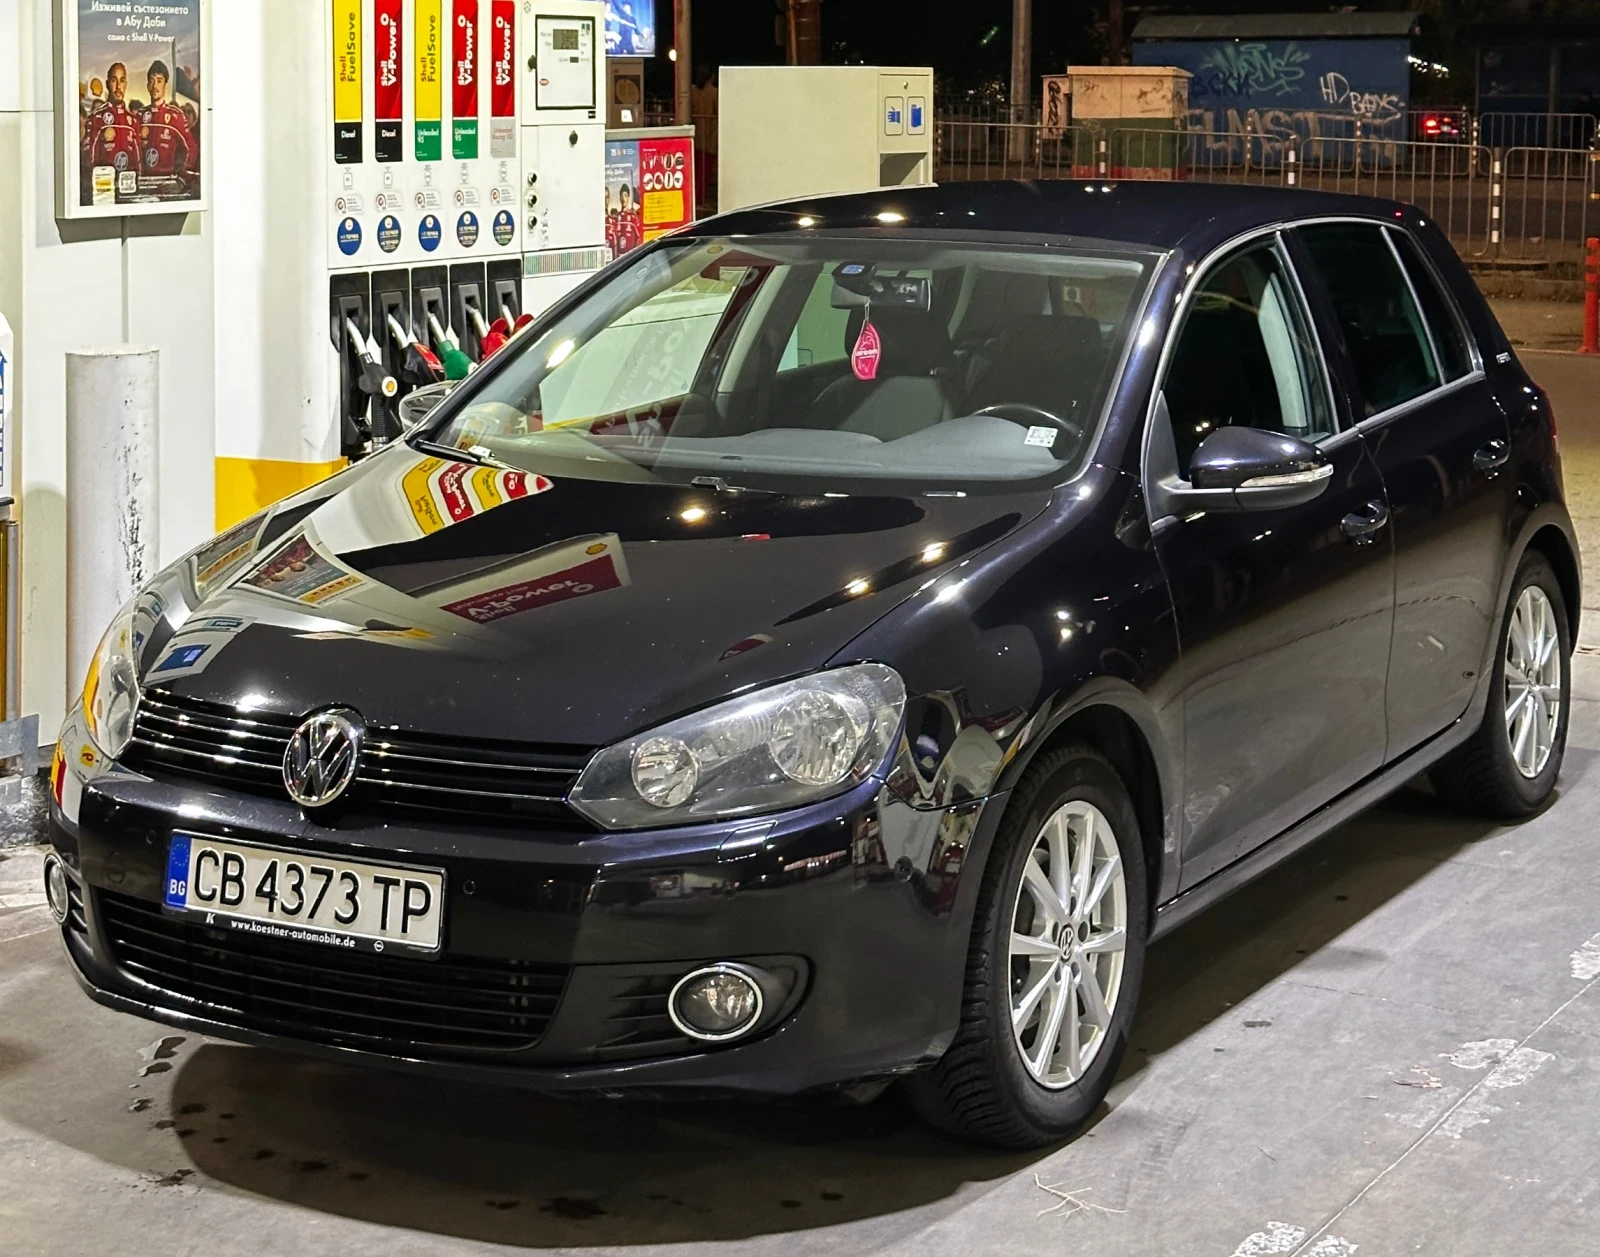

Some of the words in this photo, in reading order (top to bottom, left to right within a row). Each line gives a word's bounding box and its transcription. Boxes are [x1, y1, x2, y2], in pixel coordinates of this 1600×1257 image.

[91, 0, 132, 13] Изживей
[134, 4, 189, 15] състезанието
[124, 15, 142, 29] Абу
[346, 12, 356, 82] FuelSave
[387, 18, 397, 87] V-Power
[427, 14, 436, 82] FuelSave
[464, 20, 473, 86] V-Power
[502, 21, 511, 86] V-Power
[380, 60, 388, 87] Shell
[341, 130, 356, 139] Diesel
[381, 129, 396, 138] Diesel
[169, 879, 187, 896] BG
[194, 847, 246, 906] CB
[255, 859, 361, 925] 4373
[373, 874, 432, 935] TP
[231, 919, 356, 948] www.koestner-automobile.de
